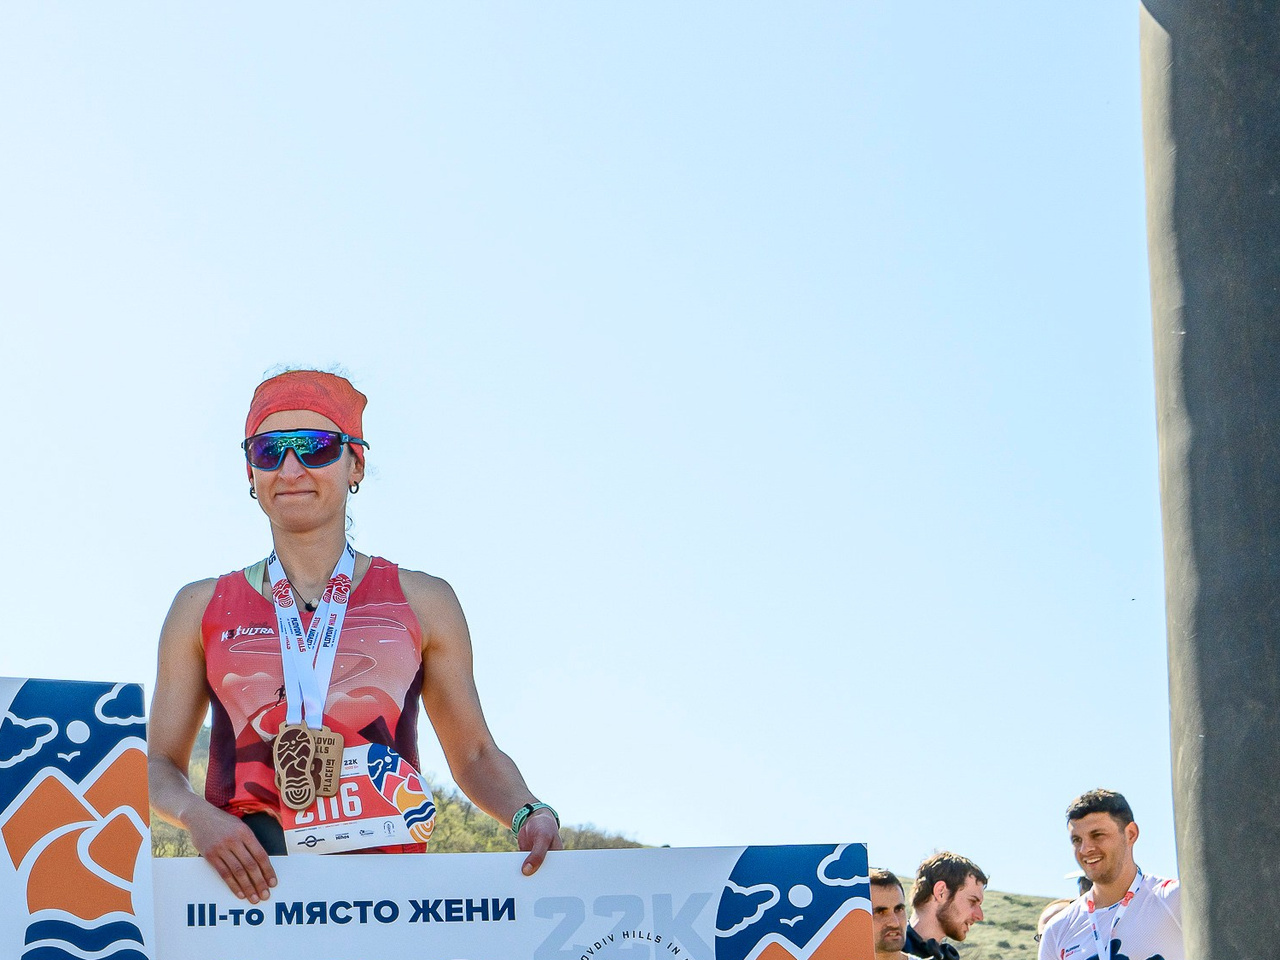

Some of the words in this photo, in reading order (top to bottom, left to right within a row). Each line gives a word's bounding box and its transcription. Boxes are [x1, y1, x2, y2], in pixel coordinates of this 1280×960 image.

[275, 899, 400, 925] МЯСТО
[408, 897, 516, 923] ЖЕНИ
[622, 930, 662, 943] HILLS
[667, 942, 681, 955] IN
